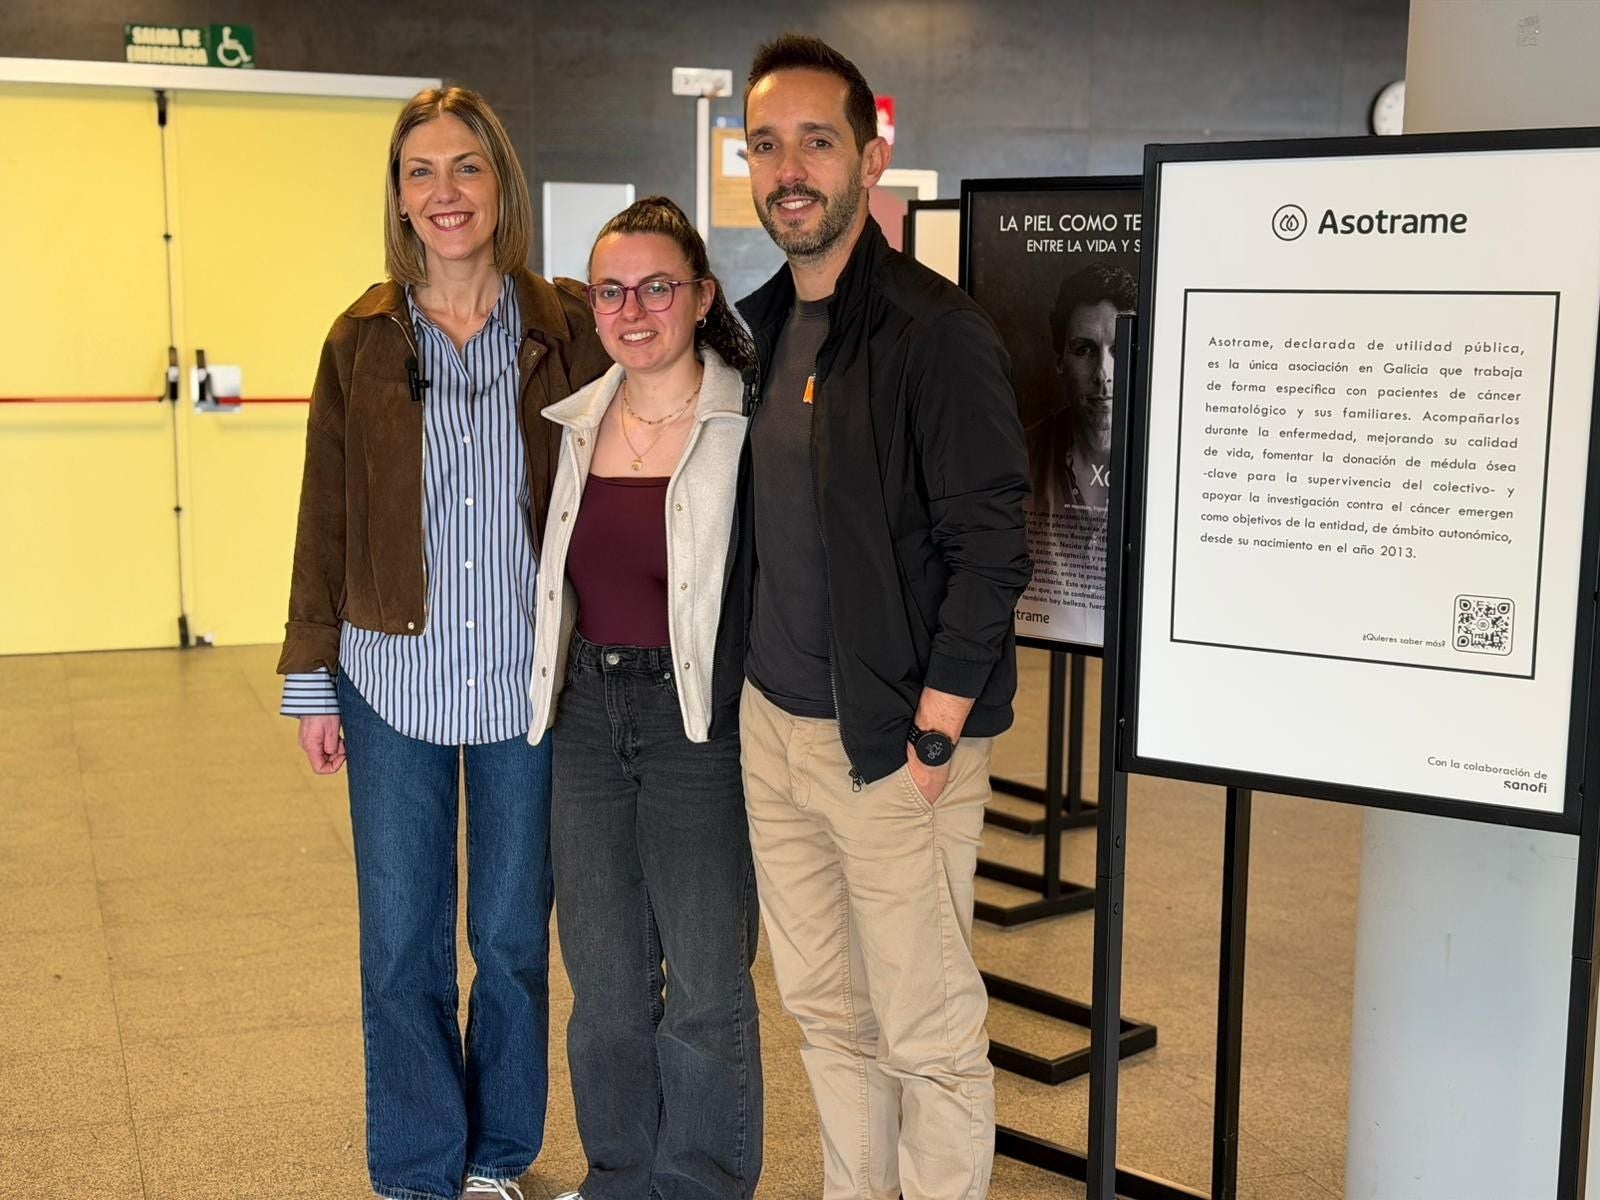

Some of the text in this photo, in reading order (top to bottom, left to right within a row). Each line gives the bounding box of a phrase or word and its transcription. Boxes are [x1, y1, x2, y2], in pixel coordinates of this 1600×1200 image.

[1000, 215, 1018, 232] LA
[1024, 214, 1054, 232] PIEL
[1059, 213, 1118, 232] COMO
[1317, 208, 1467, 234] Asotrame
[1026, 239, 1064, 253] ENTRE
[1067, 239, 1082, 253] LA
[1086, 240, 1117, 253] VIDA
[1121, 240, 1130, 252] Y
[1208, 336, 1524, 356] Asotrame, declarada de utilidad pública,
[1228, 358, 1239, 369] la
[1249, 359, 1277, 370] única
[1288, 361, 1348, 372] asociación
[1358, 365, 1372, 373] en
[1383, 362, 1428, 374] Galicia
[1439, 367, 1462, 378] que
[1473, 365, 1522, 380] trabaja
[1206, 380, 1521, 401] de forma específica con pacientes de cáncer
[1205, 402, 1519, 425] hematológico y sus familiares. Acompañarlos
[1204, 424, 1517, 448] durante la enfermedad, mejorando su calidad
[1203, 445, 1516, 472] de vida, fomentar la donación de médula ósea
[1203, 468, 1514, 498] -clave para la supervivencia del colectivo- y
[1201, 491, 1513, 520] apoyar la investigación contra el cáncer emergen
[1200, 513, 1512, 544] como objetivos de la entidad, de ámbito autonómico,
[1200, 532, 1416, 558] desde su nacimiento en el año 2013.
[1362, 633, 1445, 647] ¿Quieres saber más?
[1427, 756, 1547, 780] Con la colaboración de
[1503, 780, 1547, 793] sanofi
